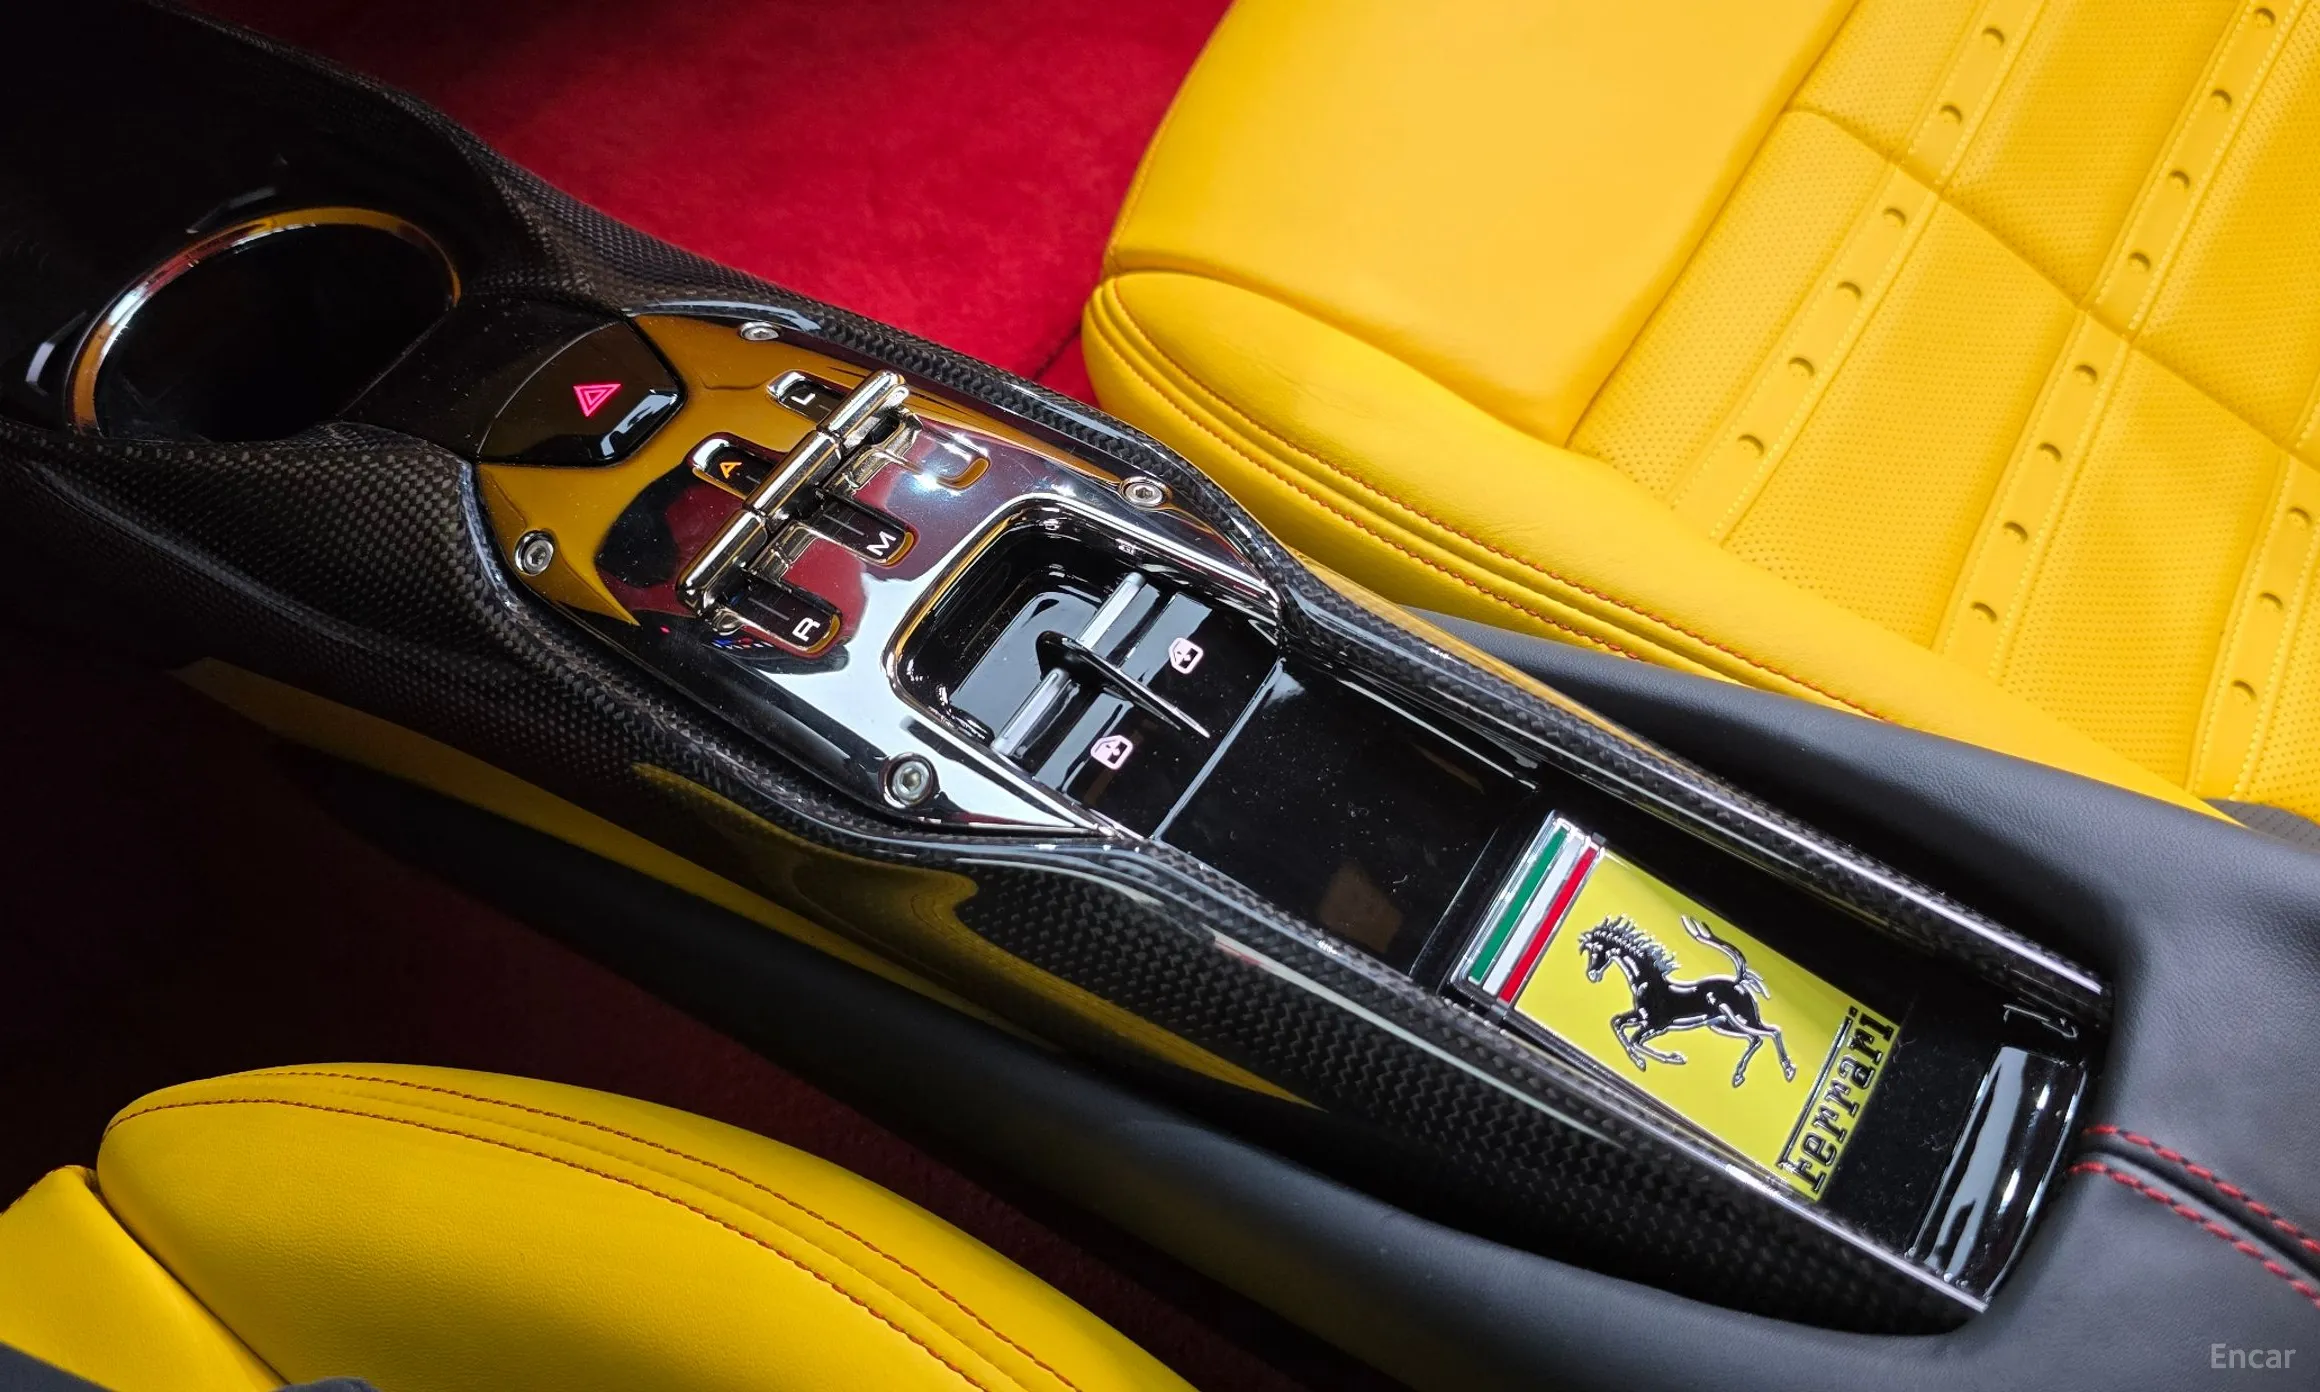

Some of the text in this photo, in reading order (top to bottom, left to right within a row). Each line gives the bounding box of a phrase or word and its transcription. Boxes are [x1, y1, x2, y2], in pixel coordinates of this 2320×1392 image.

[790, 392, 816, 406] L
[720, 461, 743, 479] A
[866, 530, 897, 556] M
[792, 617, 821, 642] R
[1775, 1005, 1895, 1195] Ferrari
